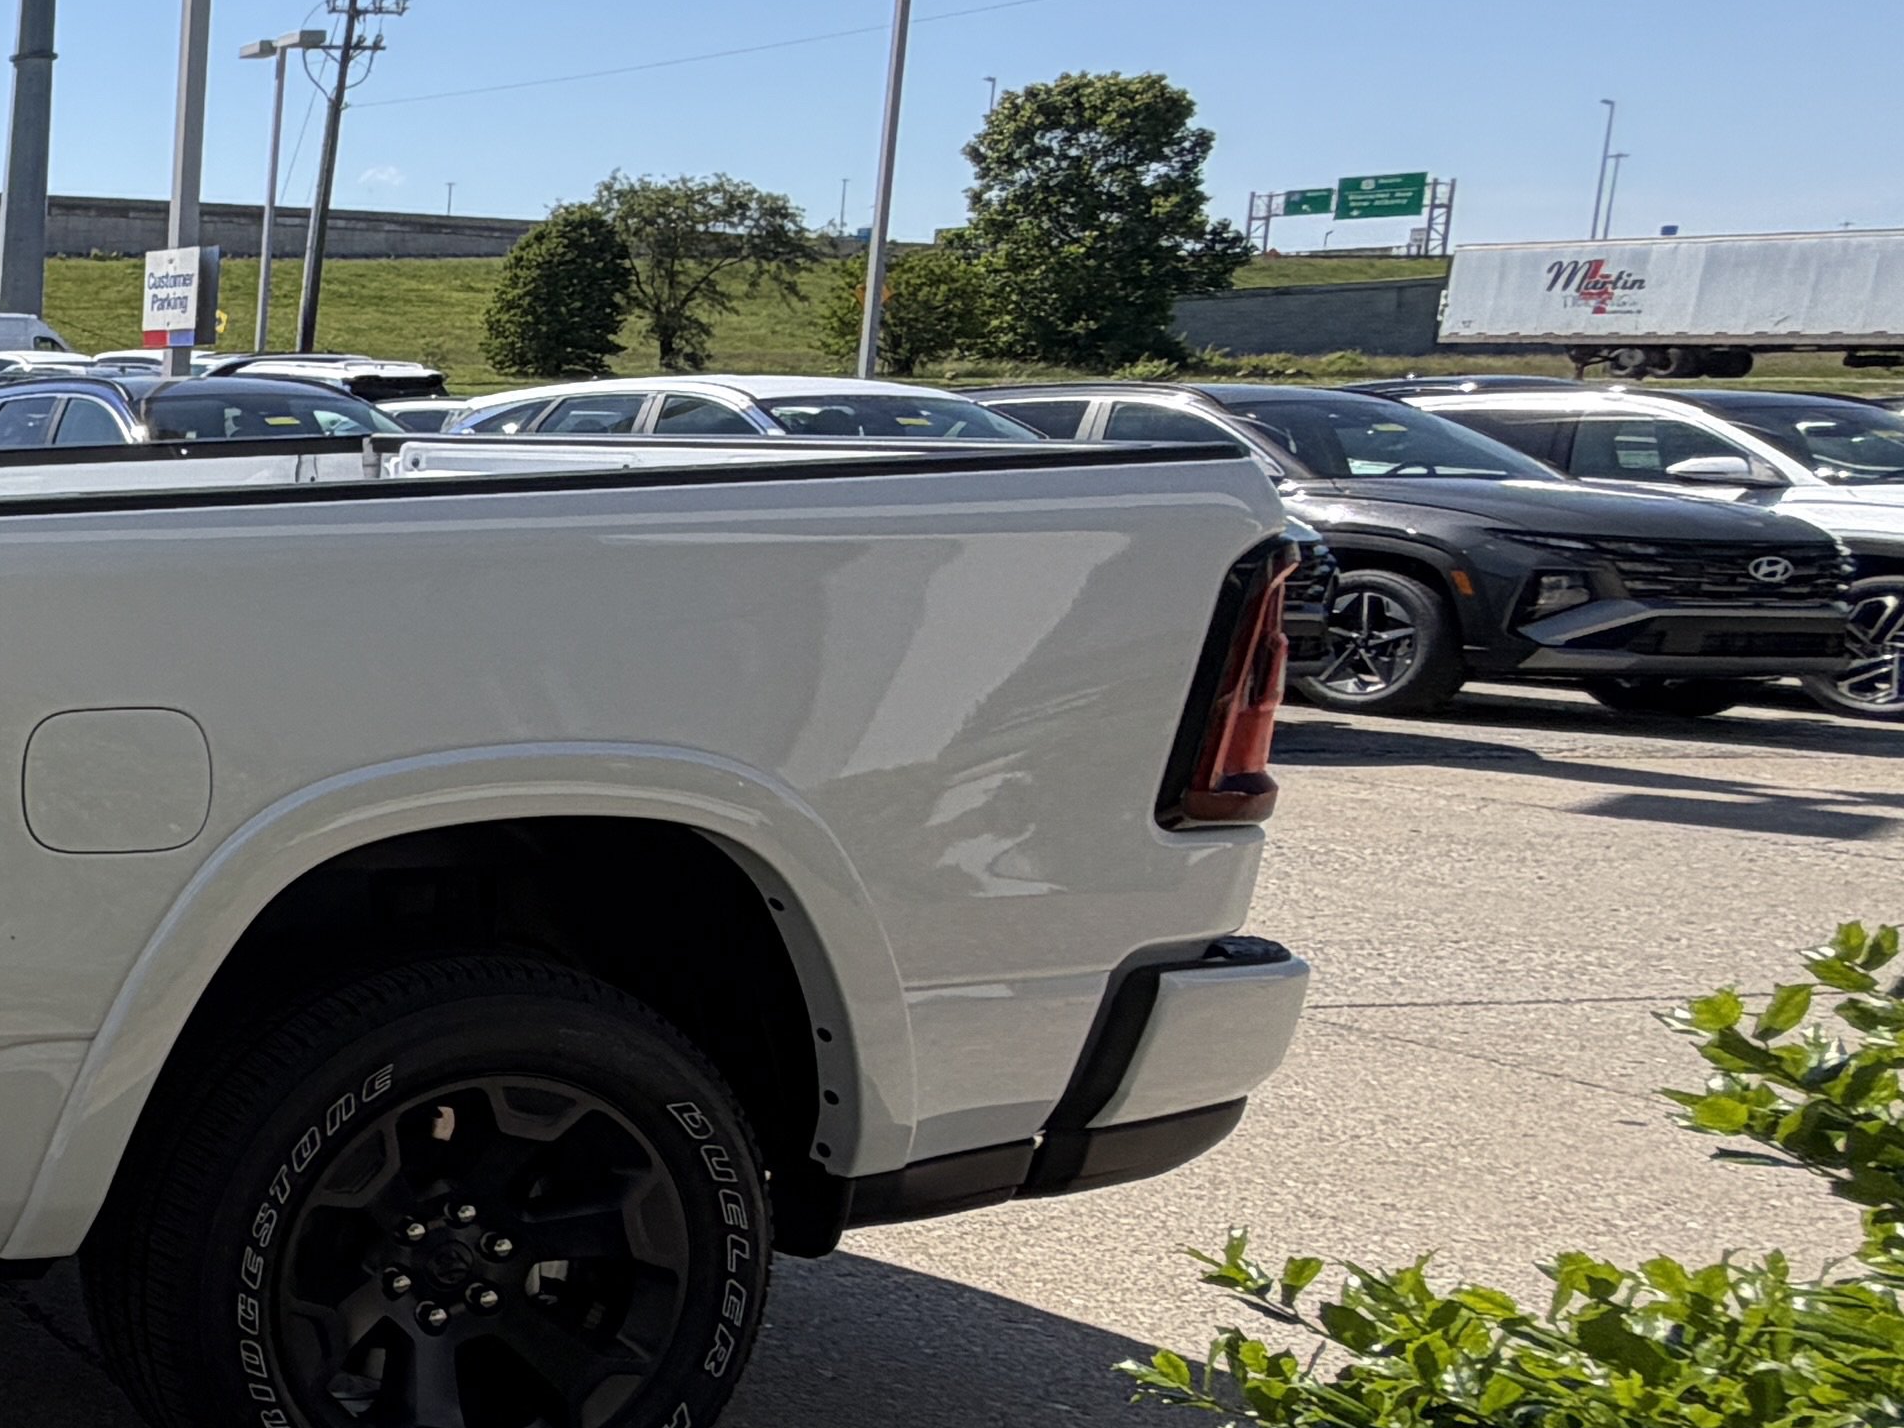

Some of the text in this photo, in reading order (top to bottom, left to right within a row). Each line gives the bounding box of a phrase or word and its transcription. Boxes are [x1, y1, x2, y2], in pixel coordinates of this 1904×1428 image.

[148, 271, 194, 290] Customer
[1545, 259, 1647, 293] Martin
[150, 292, 189, 314] Parking
[665, 1100, 750, 1381] DUELER
